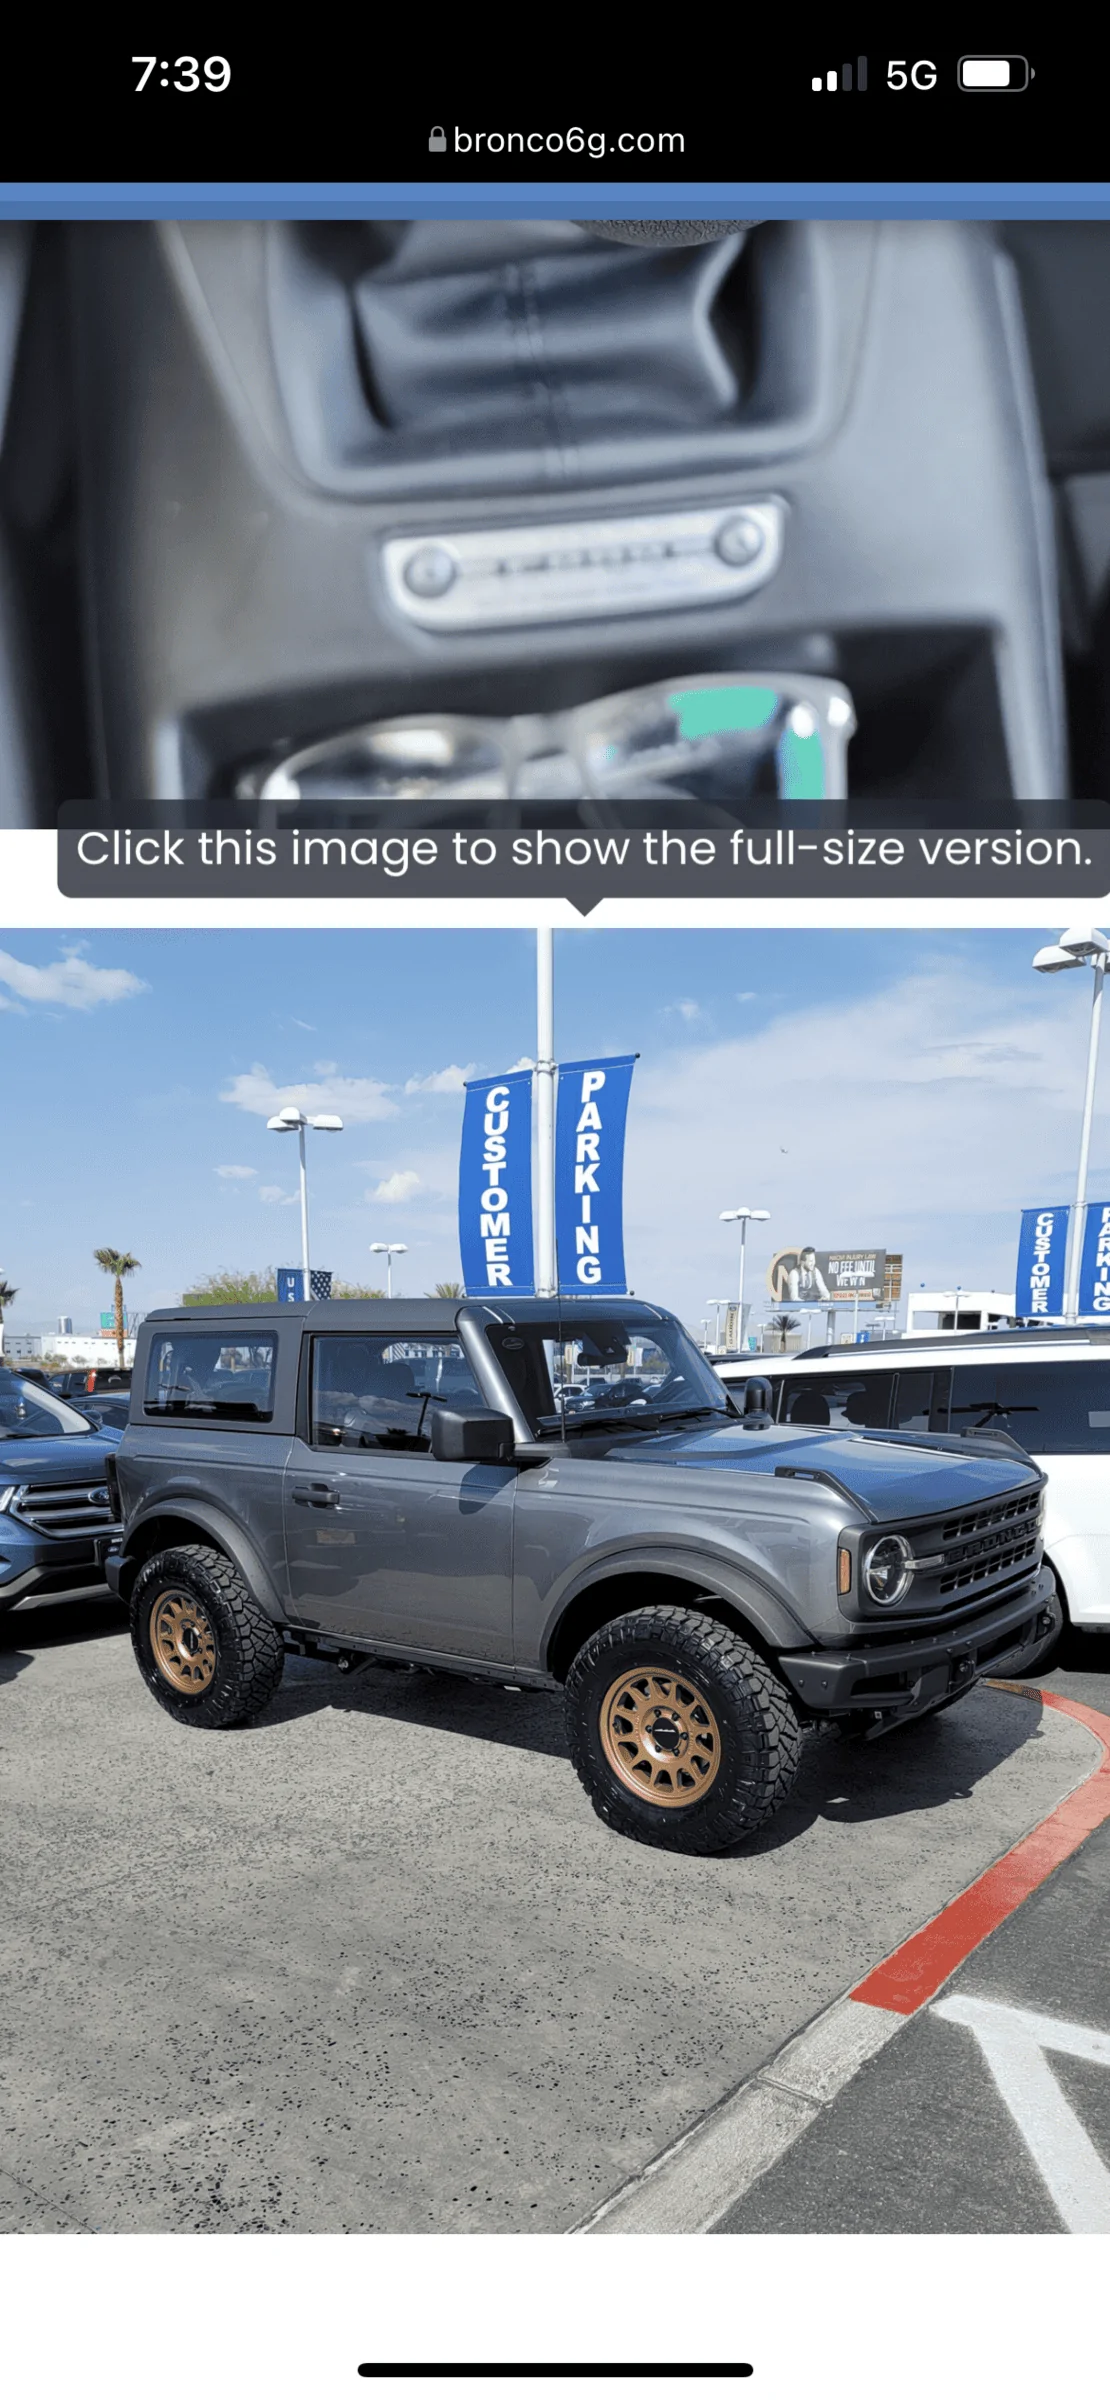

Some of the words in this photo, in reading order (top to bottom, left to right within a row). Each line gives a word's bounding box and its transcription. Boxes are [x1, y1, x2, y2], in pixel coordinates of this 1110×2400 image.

[480, 1086, 513, 1287] CUSTOMER
[574, 1070, 606, 1285] PARKING
[828, 1261, 839, 1274] NO
[1030, 1212, 1055, 1313] CUSTOMER
[945, 1518, 1038, 1563] BRONCO
